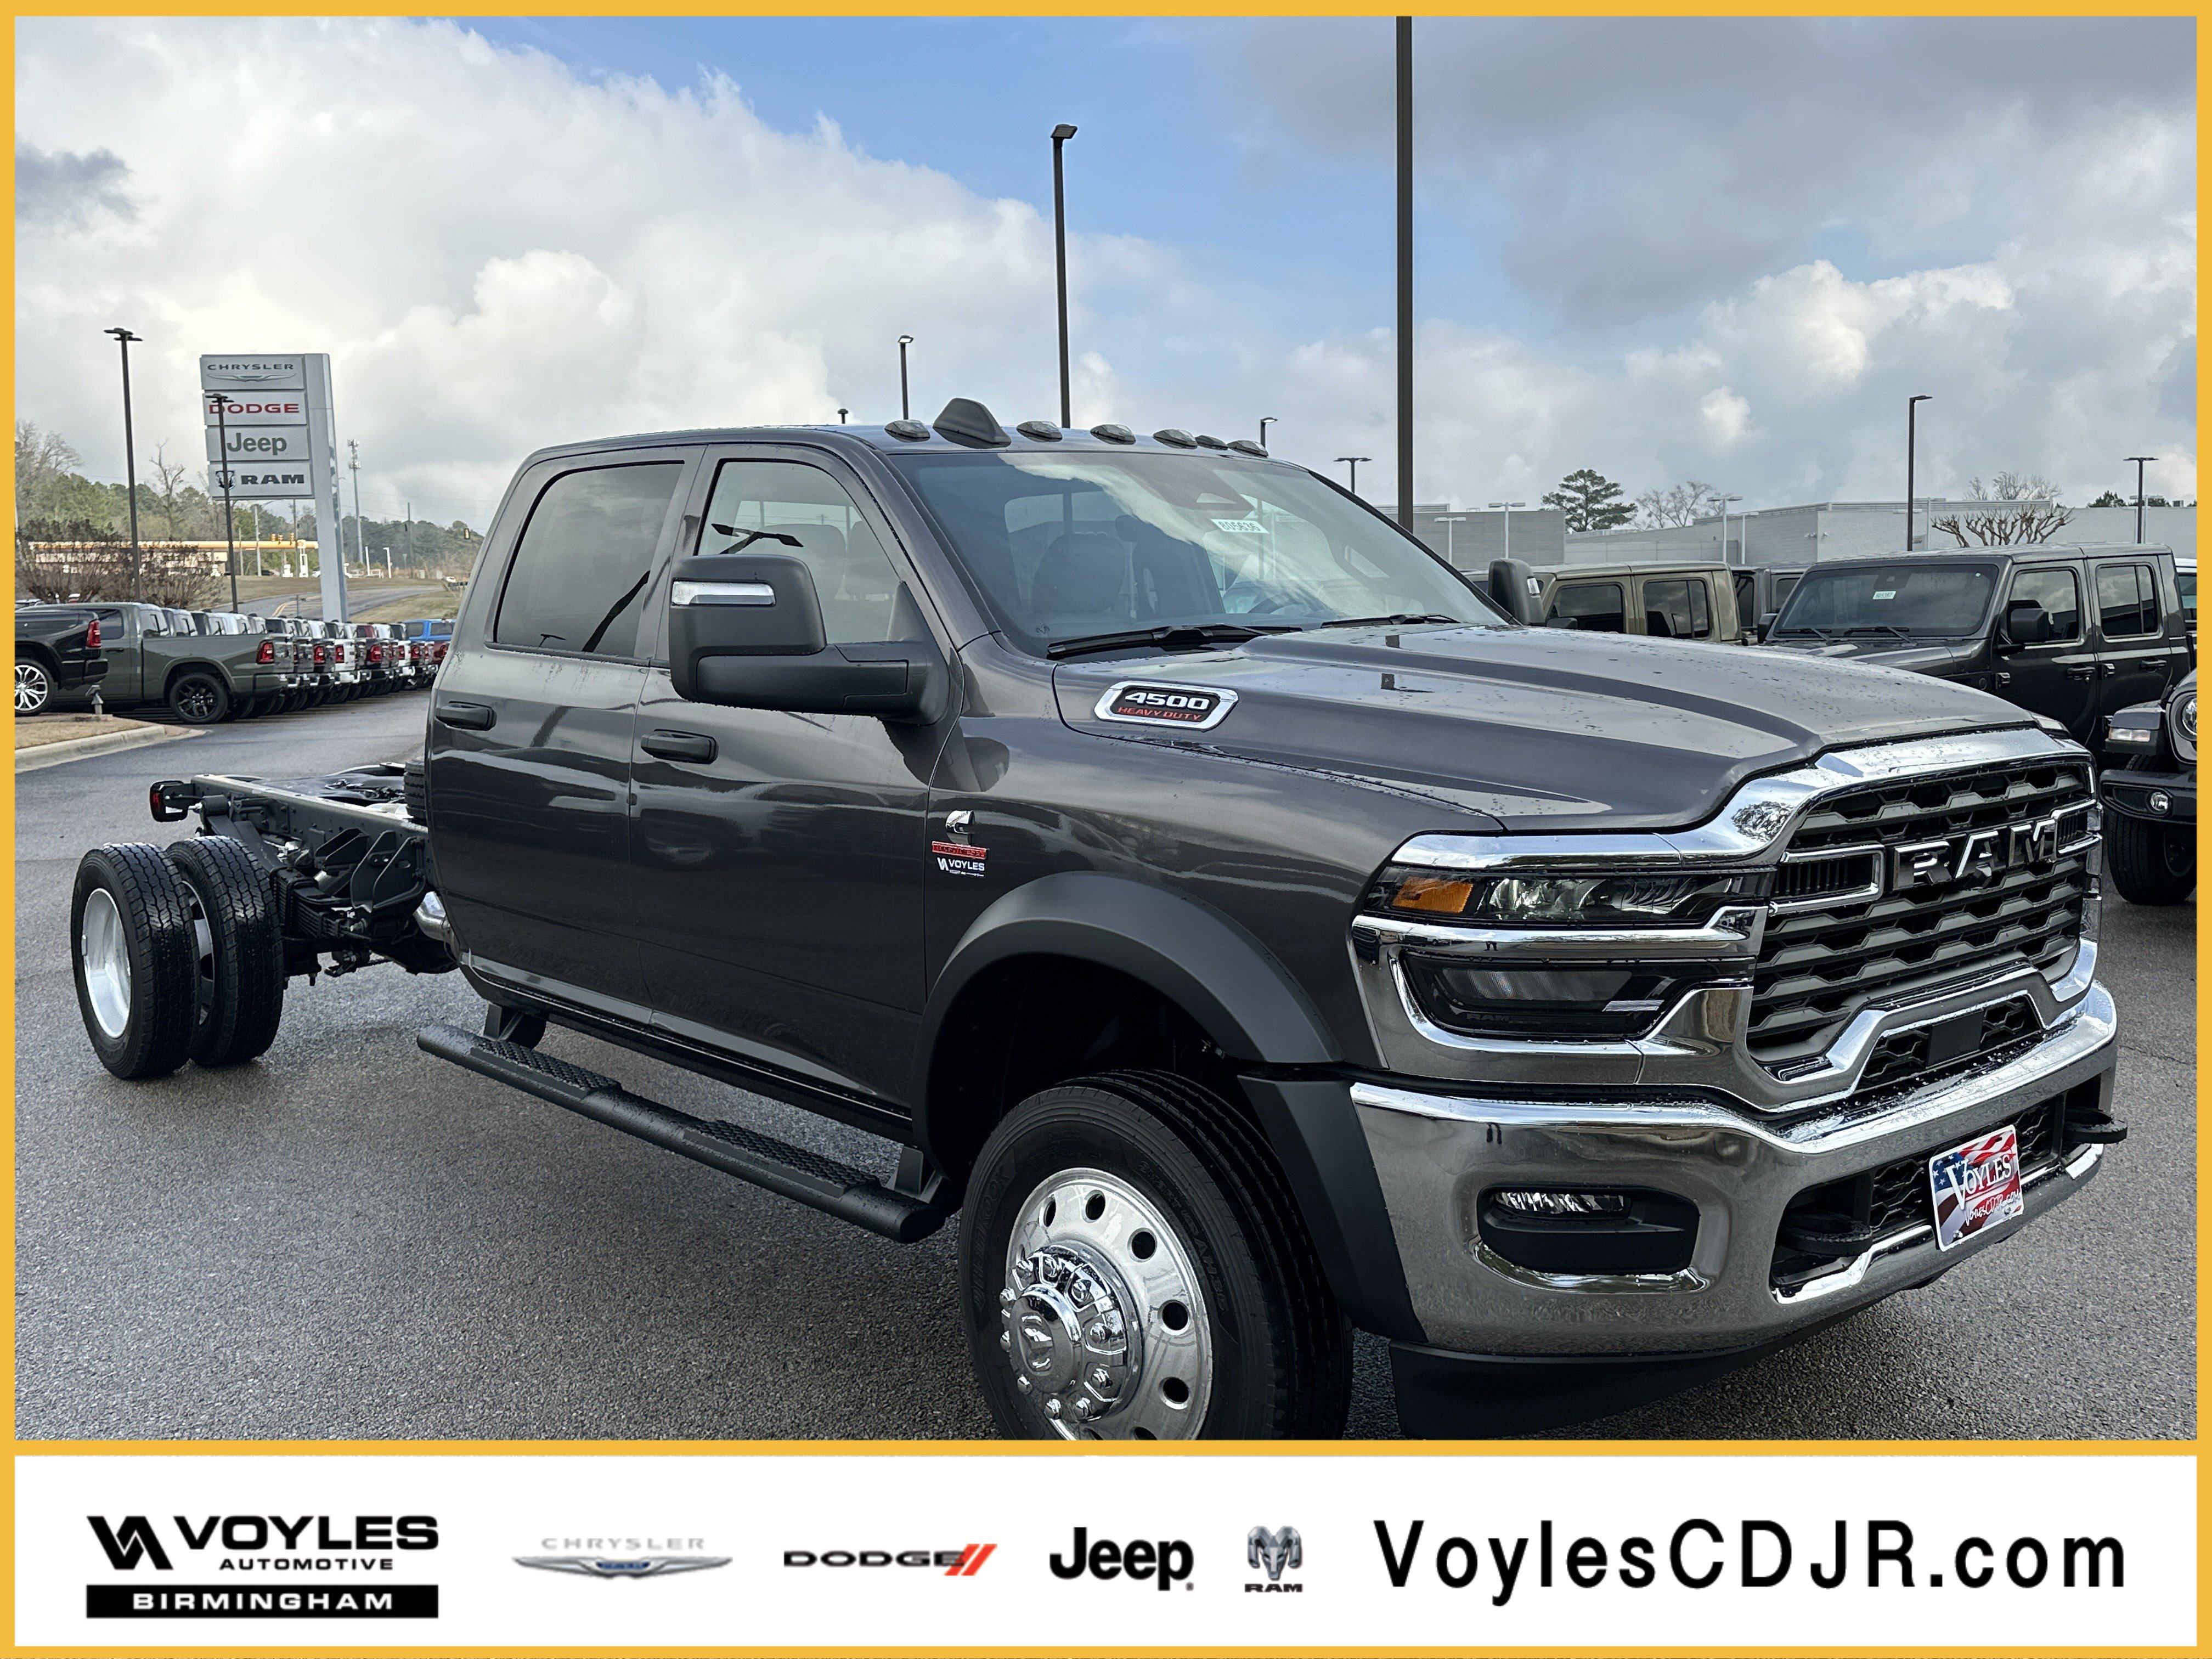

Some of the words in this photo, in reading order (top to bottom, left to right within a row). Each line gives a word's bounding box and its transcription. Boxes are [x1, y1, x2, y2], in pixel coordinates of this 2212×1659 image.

[208, 403, 300, 414] DODGE
[227, 432, 287, 455] Jeep
[241, 474, 304, 485] RAM
[1125, 692, 1210, 710] 4500
[1117, 706, 1161, 717] HEAVY
[1163, 711, 1203, 721] DUTY
[1892, 819, 2056, 891] RAM
[948, 859, 985, 871] VOYLES
[1945, 1154, 2012, 1210] VOYLES
